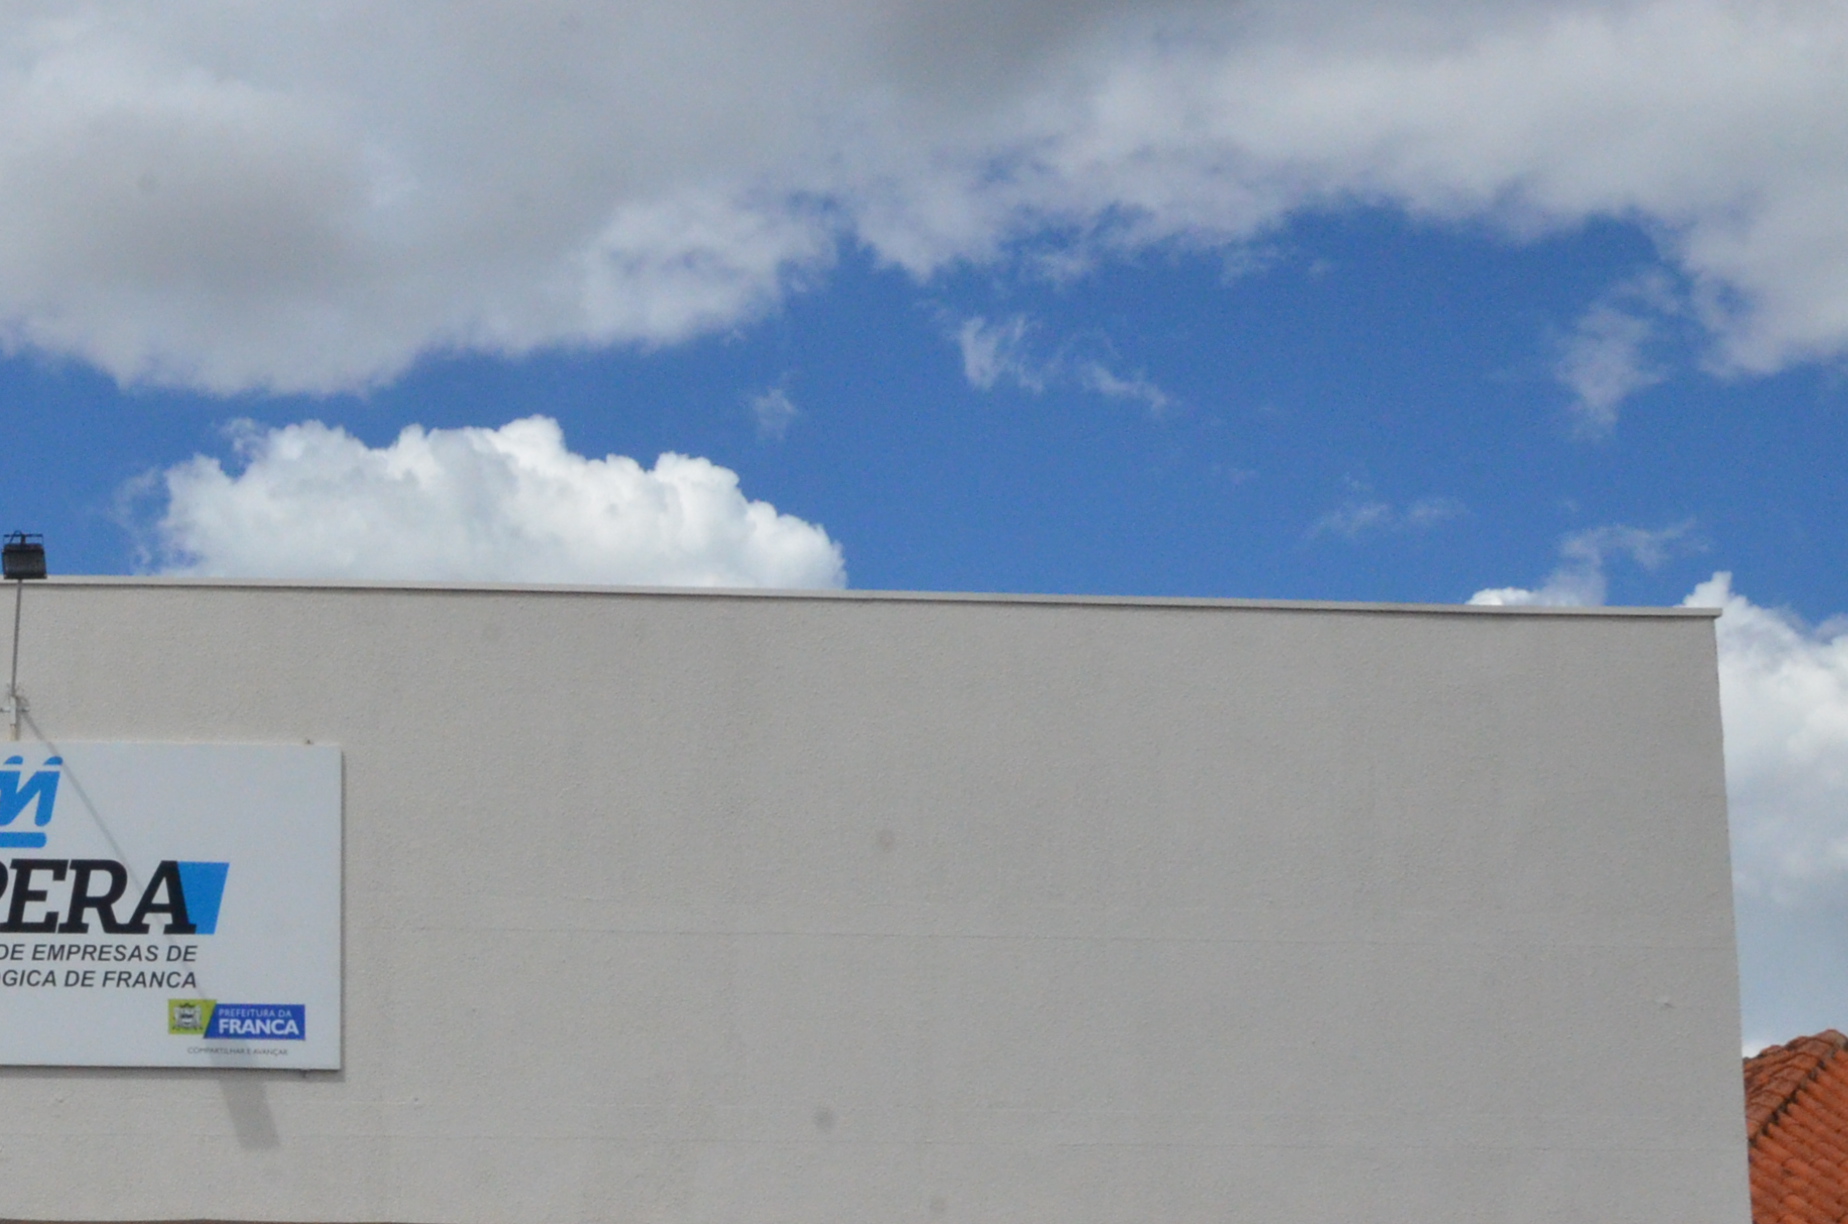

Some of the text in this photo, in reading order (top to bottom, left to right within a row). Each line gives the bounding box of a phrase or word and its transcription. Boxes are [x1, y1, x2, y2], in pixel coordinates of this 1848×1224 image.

[31, 943, 159, 962] EMPRESAS
[165, 945, 198, 963] DE
[64, 970, 96, 988] DE
[101, 970, 198, 989] FRANCA
[218, 1008, 292, 1018] PREFEITURA DA
[218, 1019, 299, 1035] FRANCA
